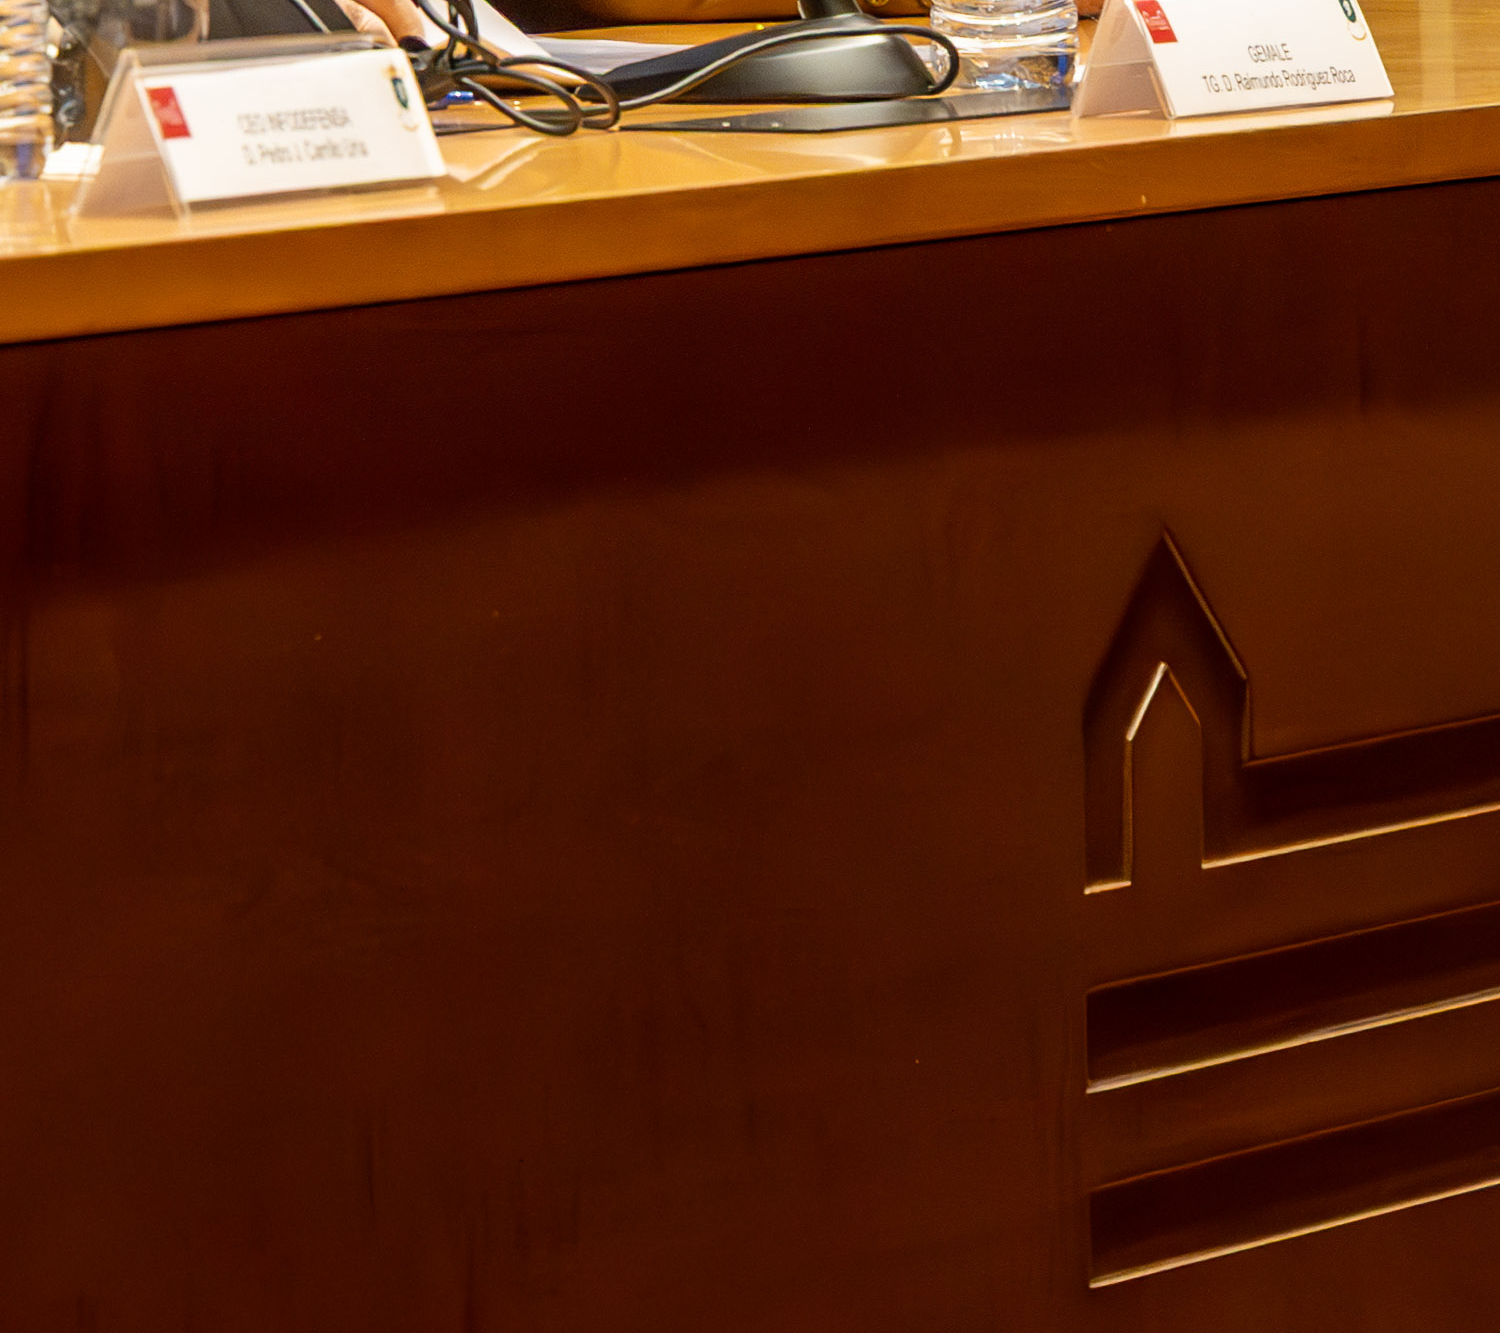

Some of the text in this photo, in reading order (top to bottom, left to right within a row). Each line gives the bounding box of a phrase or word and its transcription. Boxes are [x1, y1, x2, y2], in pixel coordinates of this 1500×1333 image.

[1247, 43, 1293, 63] GEMALE
[1221, 74, 1236, 92] D.
[1234, 71, 1284, 91] Raimundo
[1329, 66, 1357, 84] Roca
